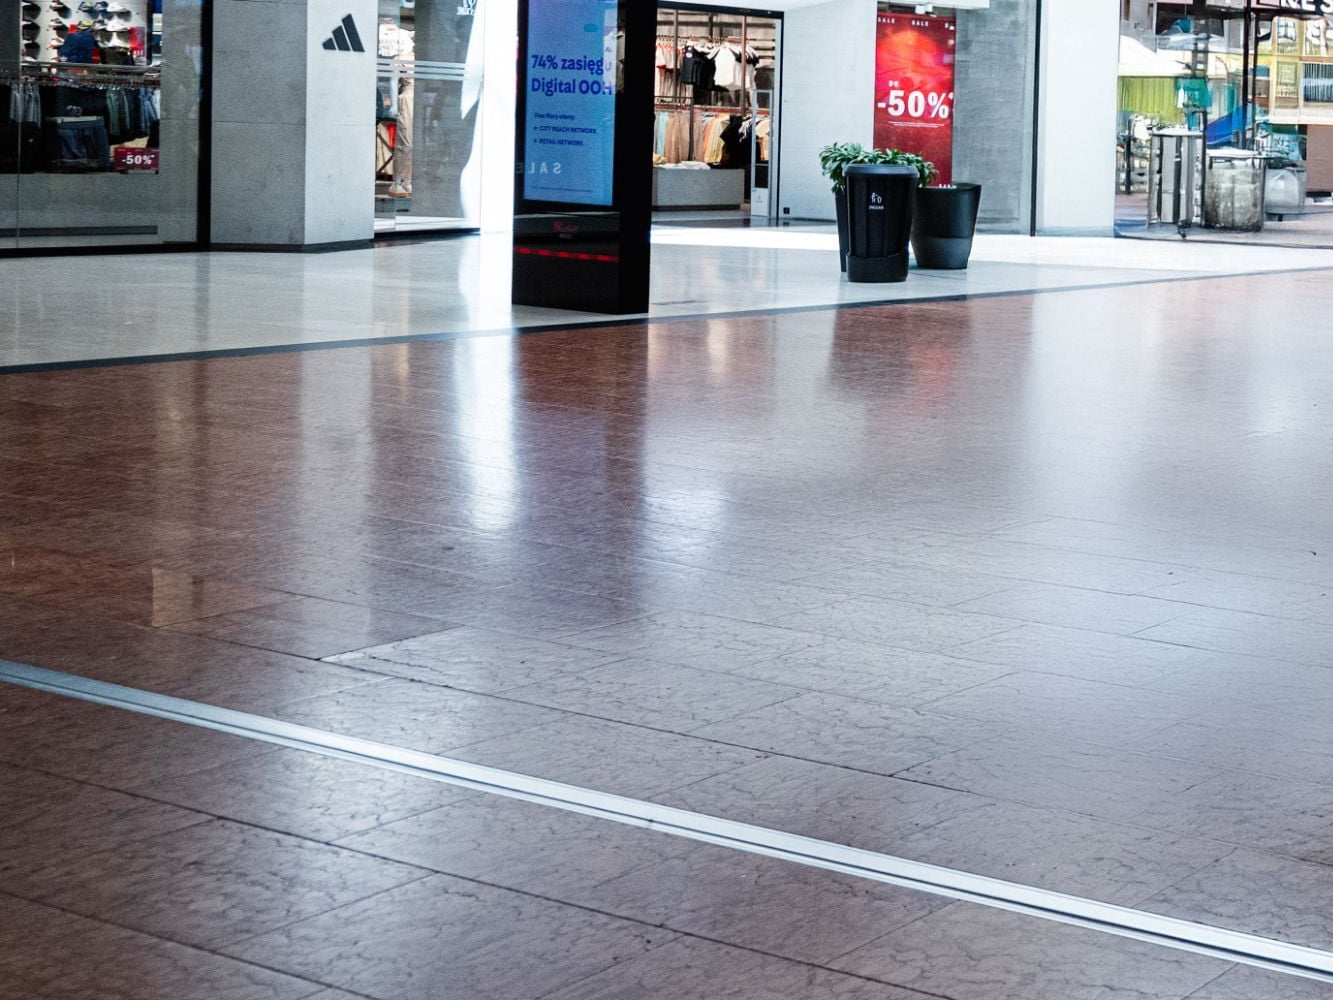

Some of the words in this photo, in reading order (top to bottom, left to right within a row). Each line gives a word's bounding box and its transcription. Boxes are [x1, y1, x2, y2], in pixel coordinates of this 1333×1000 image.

[877, 16, 896, 24] SALE
[911, 19, 929, 27] SALE
[531, 55, 558, 69] 74%
[561, 55, 612, 75] zasięgu
[531, 77, 576, 96] Digital
[579, 80, 612, 95] OOH
[571, 127, 598, 135] NETWORK
